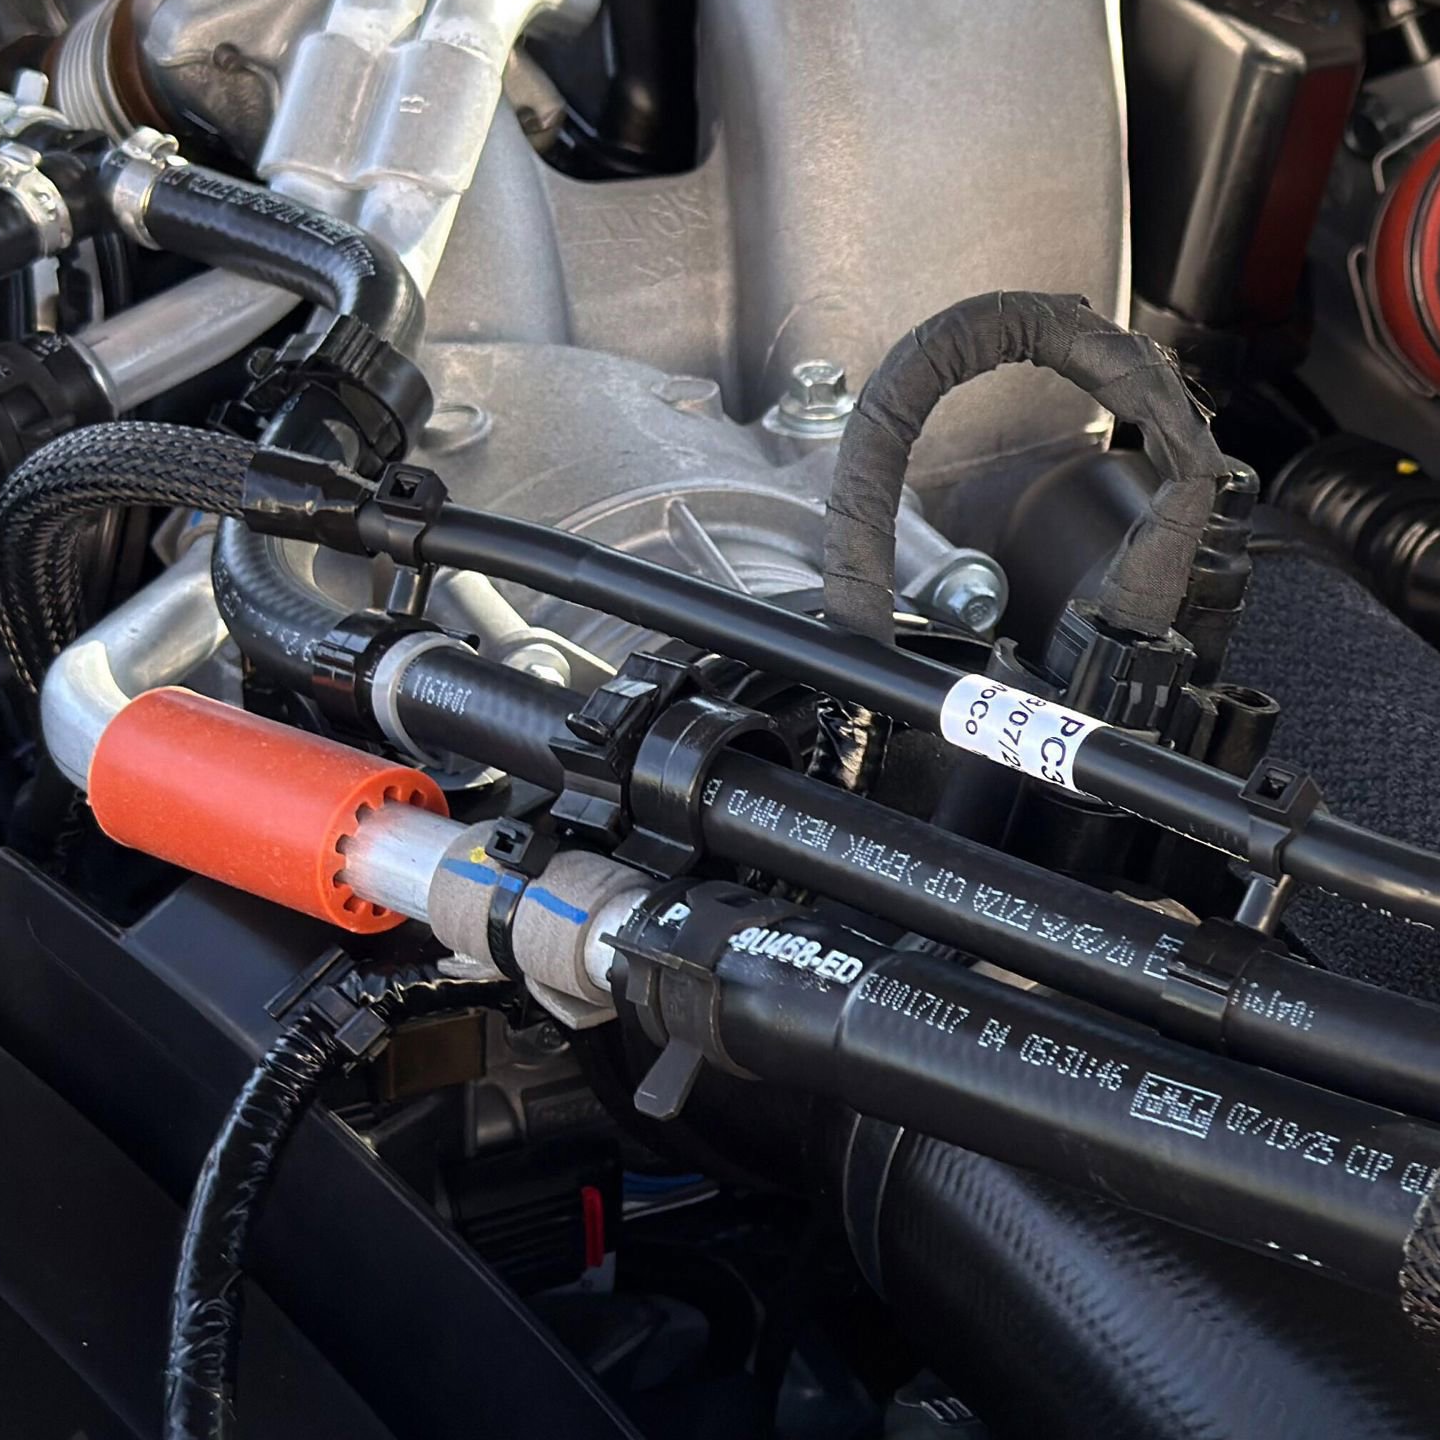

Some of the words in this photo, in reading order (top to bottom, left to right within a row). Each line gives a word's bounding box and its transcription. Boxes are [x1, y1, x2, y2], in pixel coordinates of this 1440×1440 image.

[789, 810, 835, 852] MEX
[924, 869, 966, 904] CIP
[1020, 1033, 1129, 1092] 05:31:46
[1225, 1102, 1340, 1165] 07/19/25
[1345, 1143, 1394, 1182] CIP
